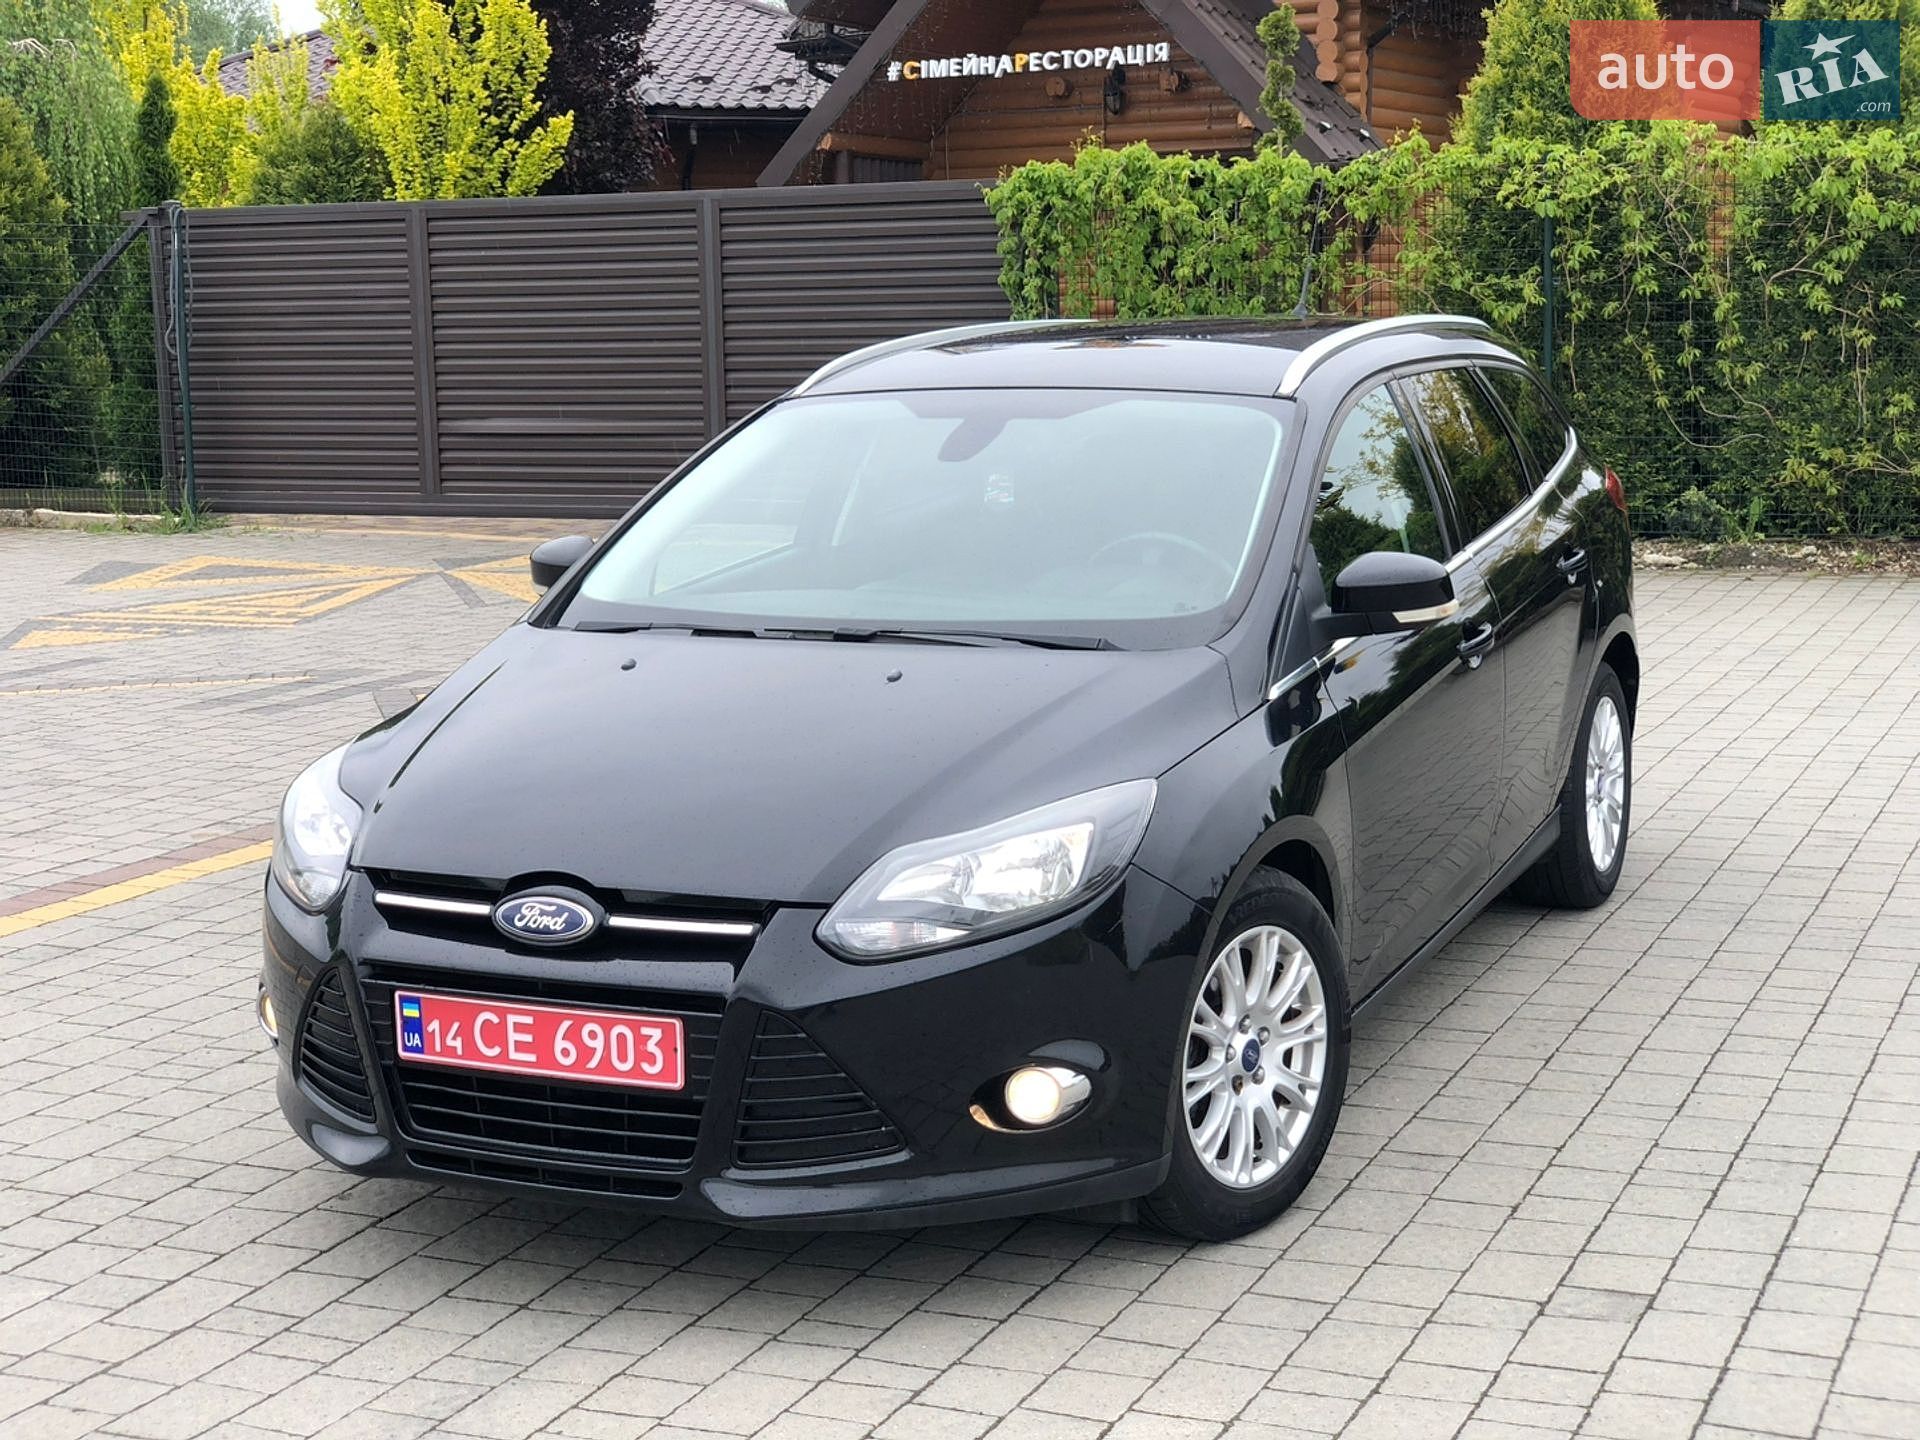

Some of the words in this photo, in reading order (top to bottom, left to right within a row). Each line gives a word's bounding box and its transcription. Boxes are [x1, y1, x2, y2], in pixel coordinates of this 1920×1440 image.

[513, 901, 569, 931] Ford
[404, 1032, 422, 1048] UA
[426, 1018, 463, 1055] 14
[473, 1011, 537, 1063] CE
[553, 1019, 665, 1075] 6903
